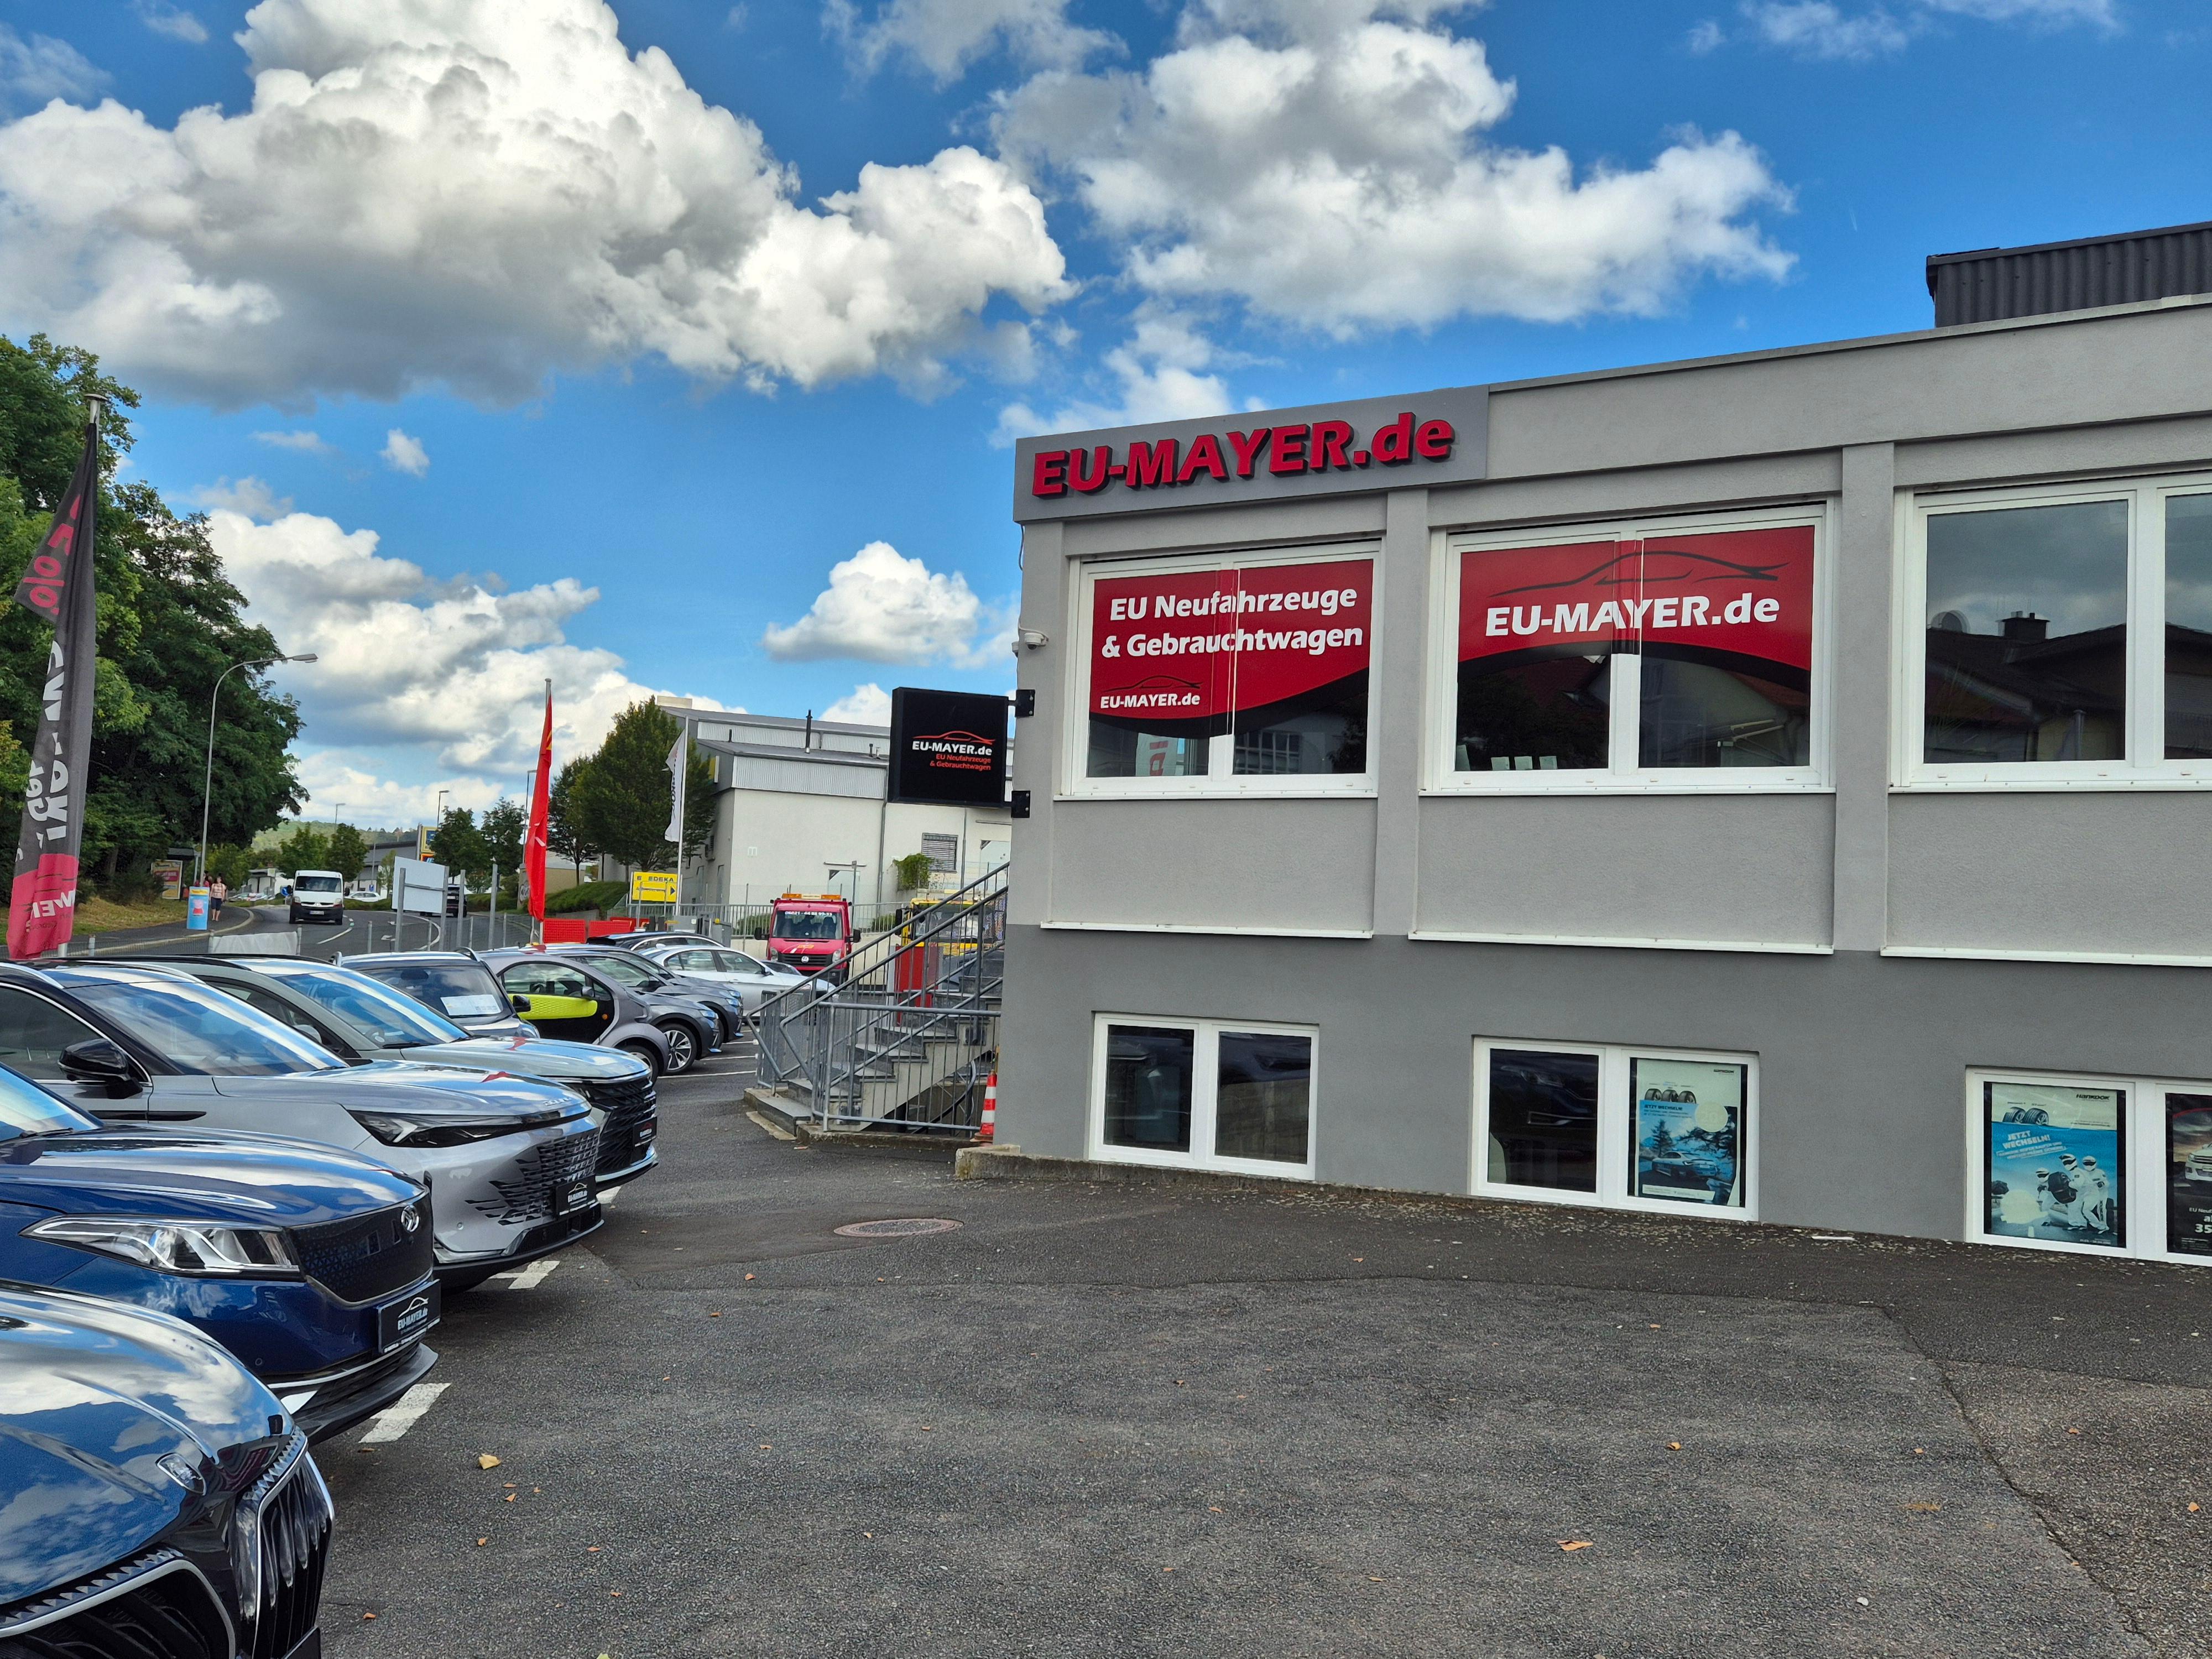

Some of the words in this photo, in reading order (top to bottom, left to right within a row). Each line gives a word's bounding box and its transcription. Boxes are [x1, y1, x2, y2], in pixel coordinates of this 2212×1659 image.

[1032, 411, 1455, 497] EU-MAYER.de
[1110, 596, 1147, 621] EU
[1155, 587, 1358, 619] Neufahrzeuge
[1485, 593, 1779, 637] EU-MAYER.de
[1102, 639, 1121, 658] &
[1127, 627, 1363, 656] Gebrauchtwagen
[1100, 692, 1201, 709] EU-MAYER.de
[912, 740, 993, 755] EU-MAYER.de
[936, 761, 991, 771] Gebrauchtwagen
[947, 754, 991, 763] Neufahrzeuge
[2002, 1134, 2051, 1150] WECHSELN!
[2007, 1130, 2031, 1141] JETZT
